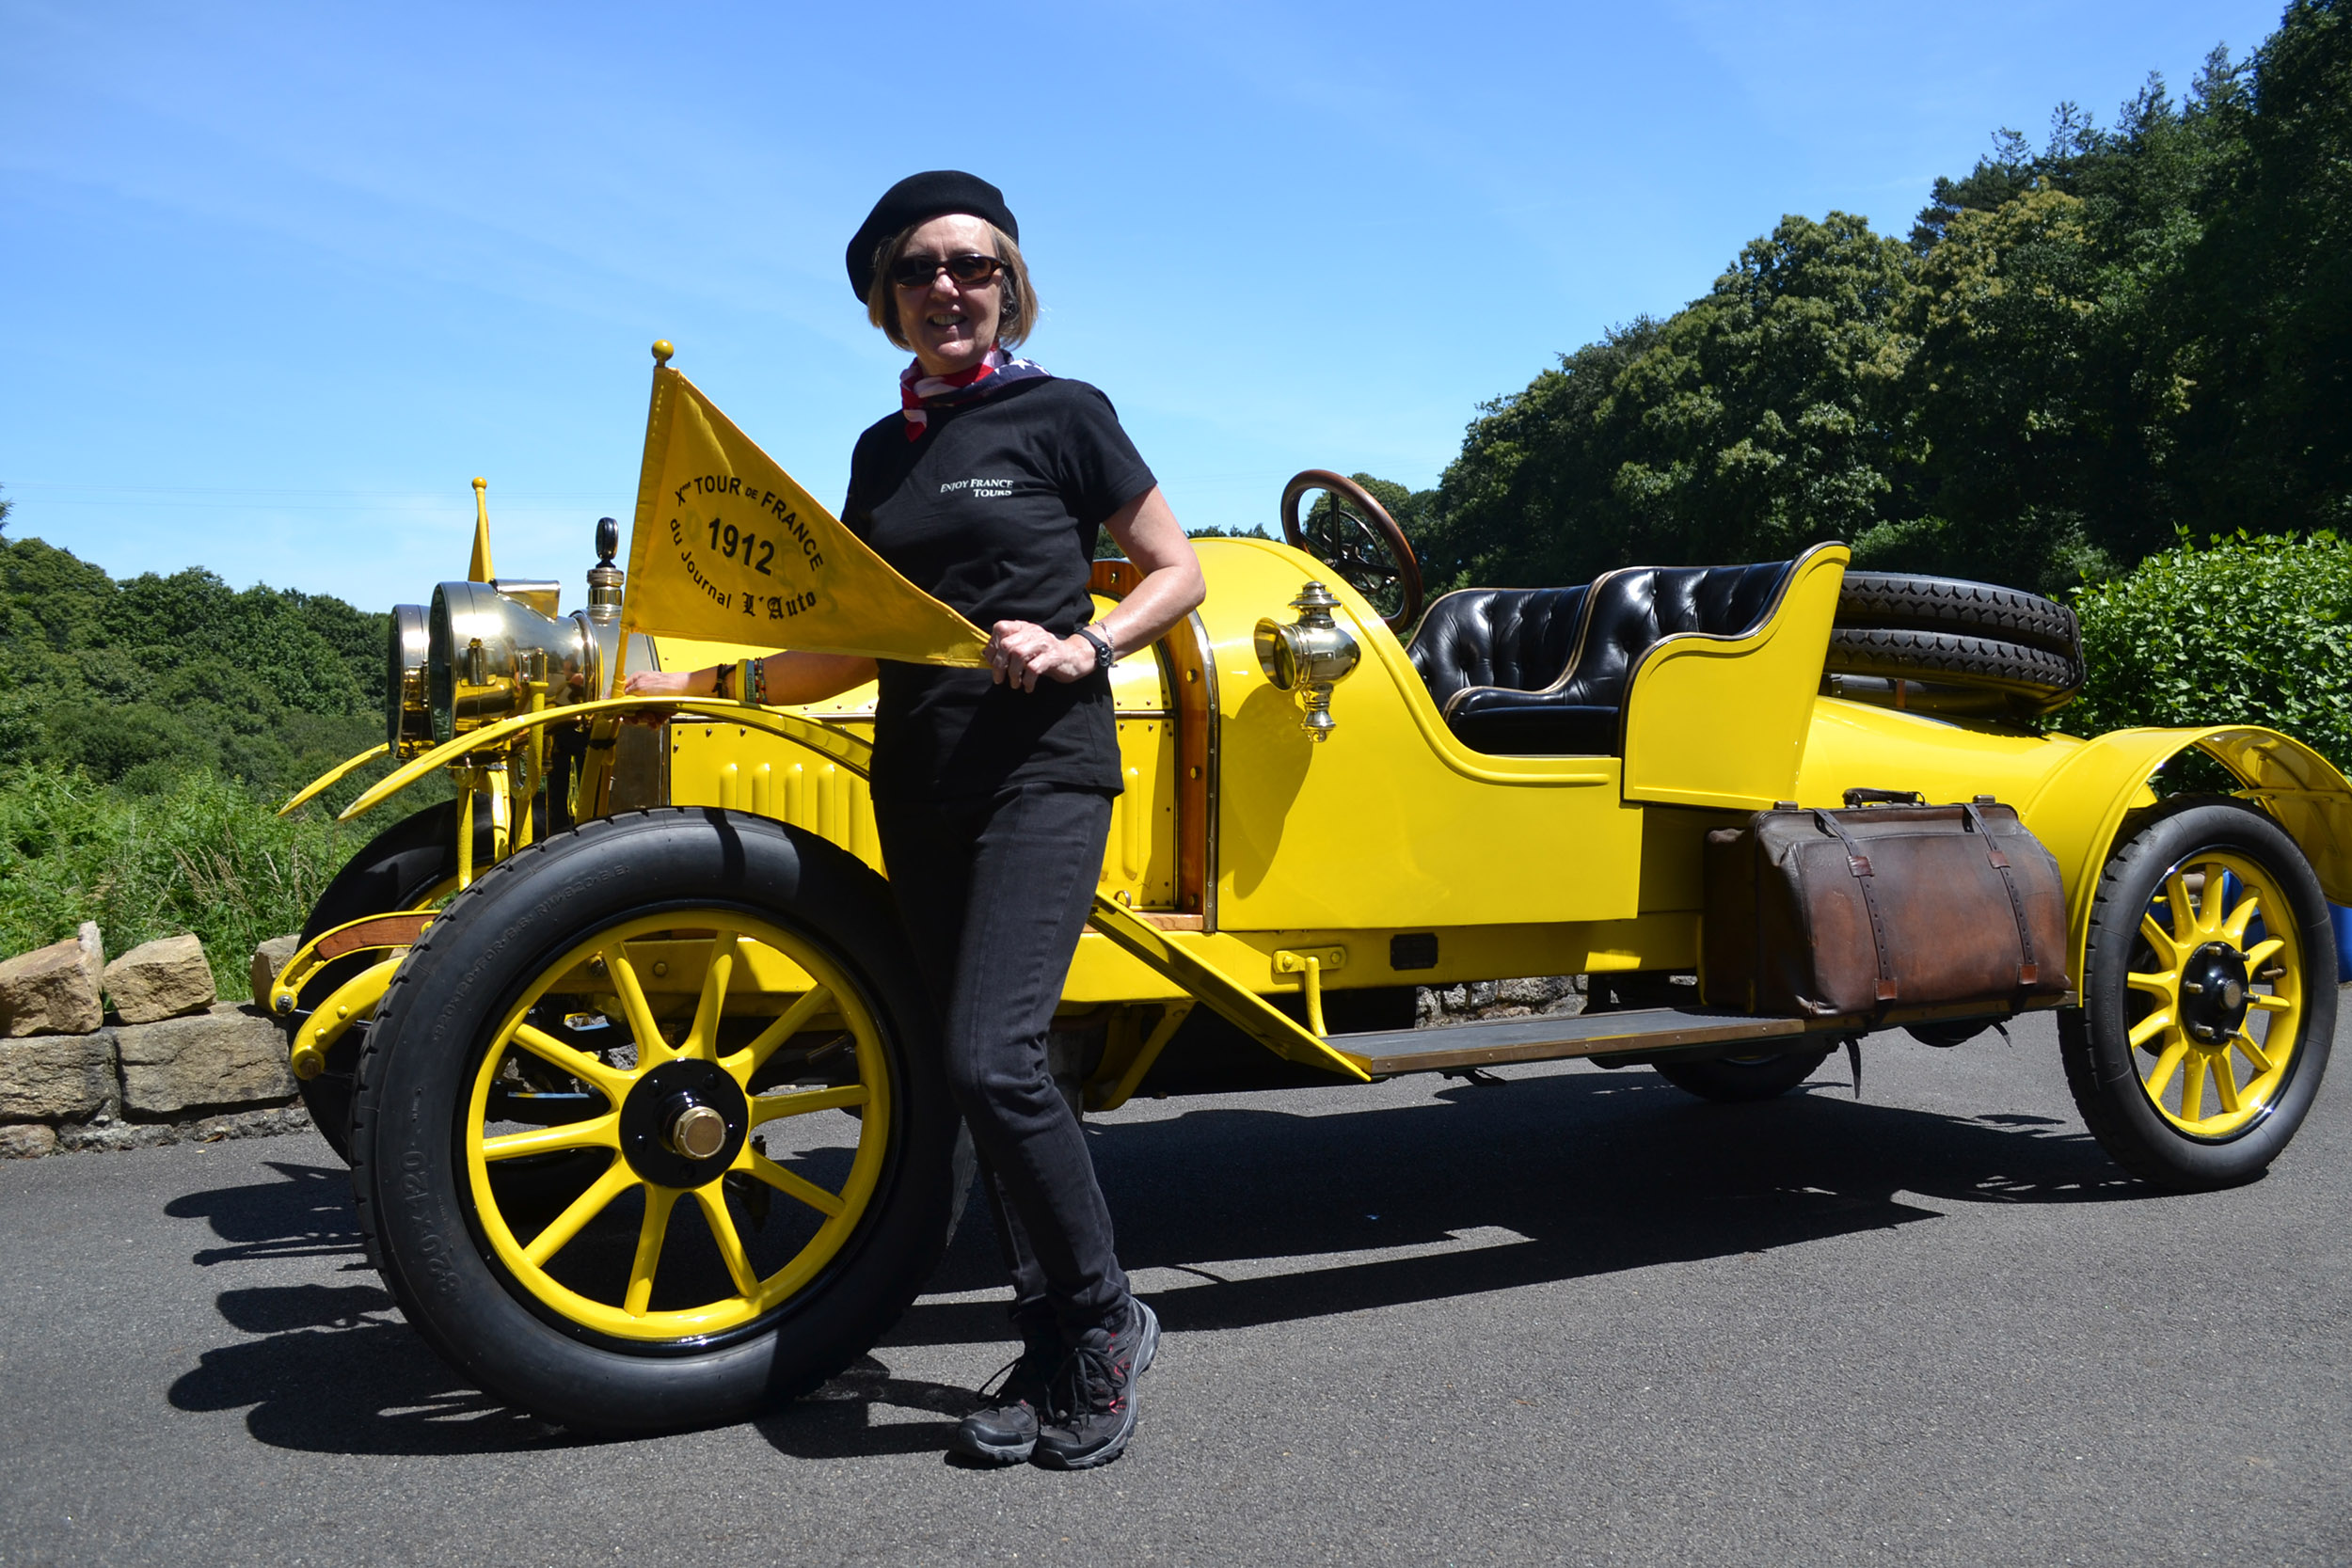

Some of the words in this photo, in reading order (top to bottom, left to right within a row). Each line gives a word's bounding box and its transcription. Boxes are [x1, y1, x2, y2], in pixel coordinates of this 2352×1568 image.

[940, 480, 969, 493] ENJOY
[970, 478, 1014, 488] FRANCE
[973, 489, 1012, 498] TOURS
[694, 475, 741, 496] TOUR
[745, 487, 758, 499] DE
[761, 491, 823, 572] FRANCE
[708, 517, 774, 576] 1912
[670, 518, 682, 546] du
[681, 550, 732, 610] Journal
